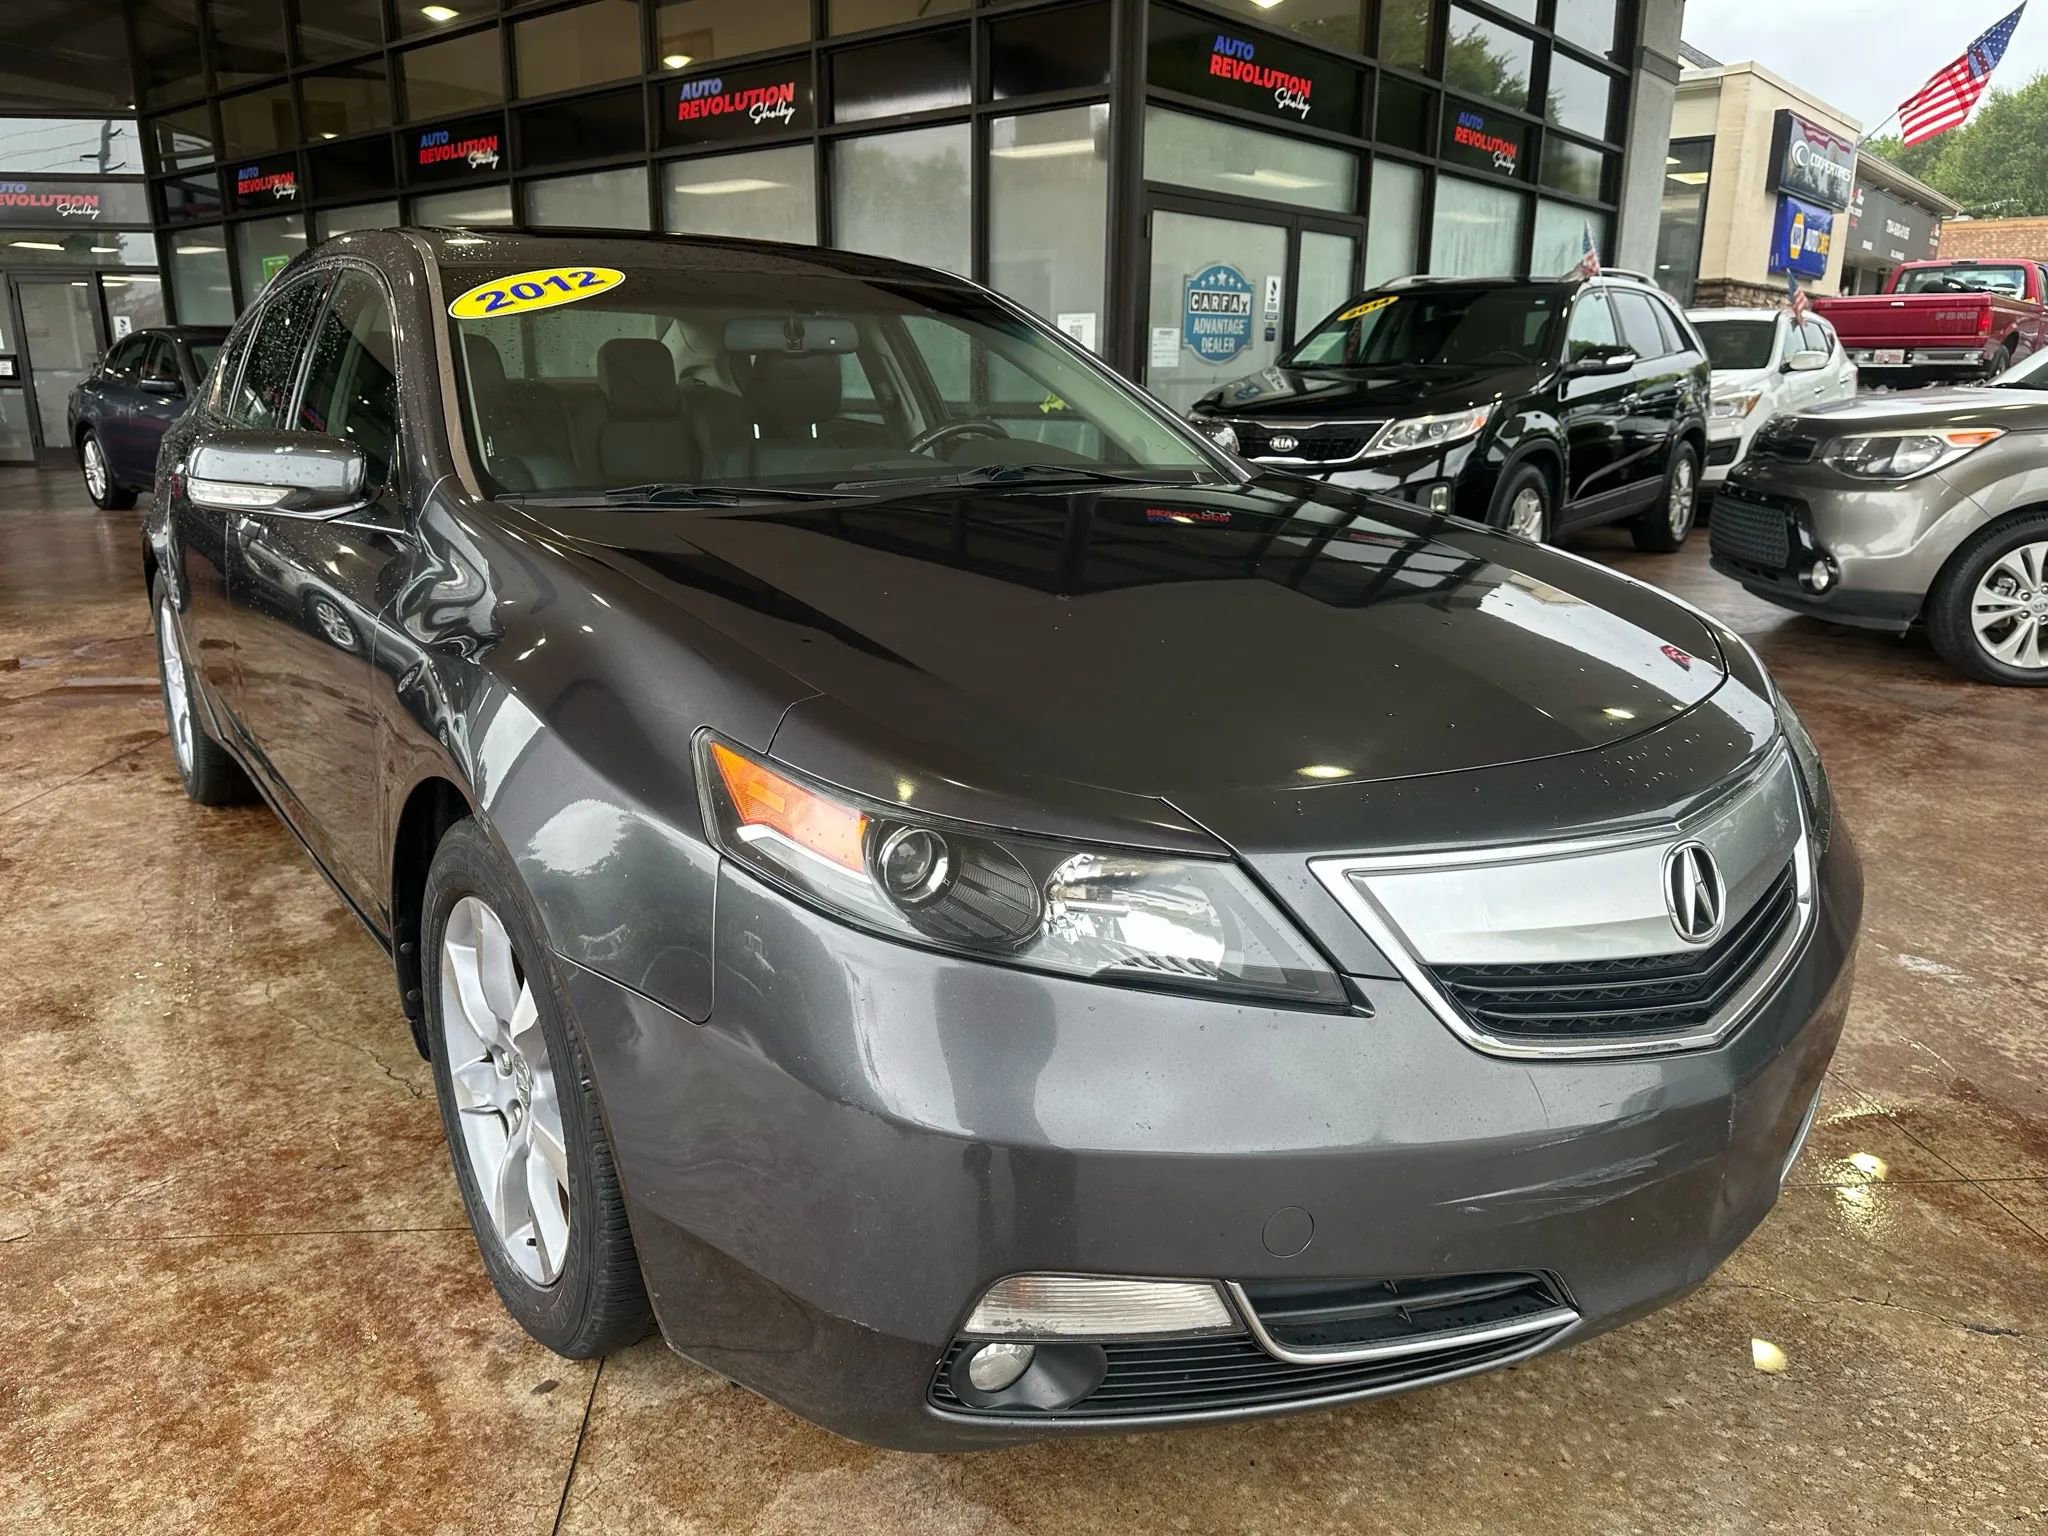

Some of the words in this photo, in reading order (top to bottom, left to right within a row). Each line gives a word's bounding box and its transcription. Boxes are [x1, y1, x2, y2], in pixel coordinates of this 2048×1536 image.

[1213, 35, 1255, 61] AUTO
[1209, 53, 1313, 98] REVOLUTION
[680, 78, 723, 100] AUTO
[678, 81, 795, 121] REVOLUTION
[748, 97, 796, 125] Shelby
[1274, 87, 1312, 120] Shelby
[1458, 111, 1484, 131] AUTO
[419, 135, 498, 165] REVOLUTION
[420, 130, 449, 148] AUTO
[1454, 126, 1518, 160] REVOLUTION
[238, 166, 259, 180] AUTO
[238, 171, 295, 195] REVOLUTION
[0, 183, 27, 193] UTO
[0, 193, 99, 207] EVOLUTION
[56, 202, 101, 220] Shelby
[475, 270, 606, 313] 2012
[1190, 292, 1249, 314] CARFAX
[1192, 317, 1246, 335] ADVANTAGE
[1201, 336, 1236, 353] DEALER
[1272, 436, 1293, 449] KIA
